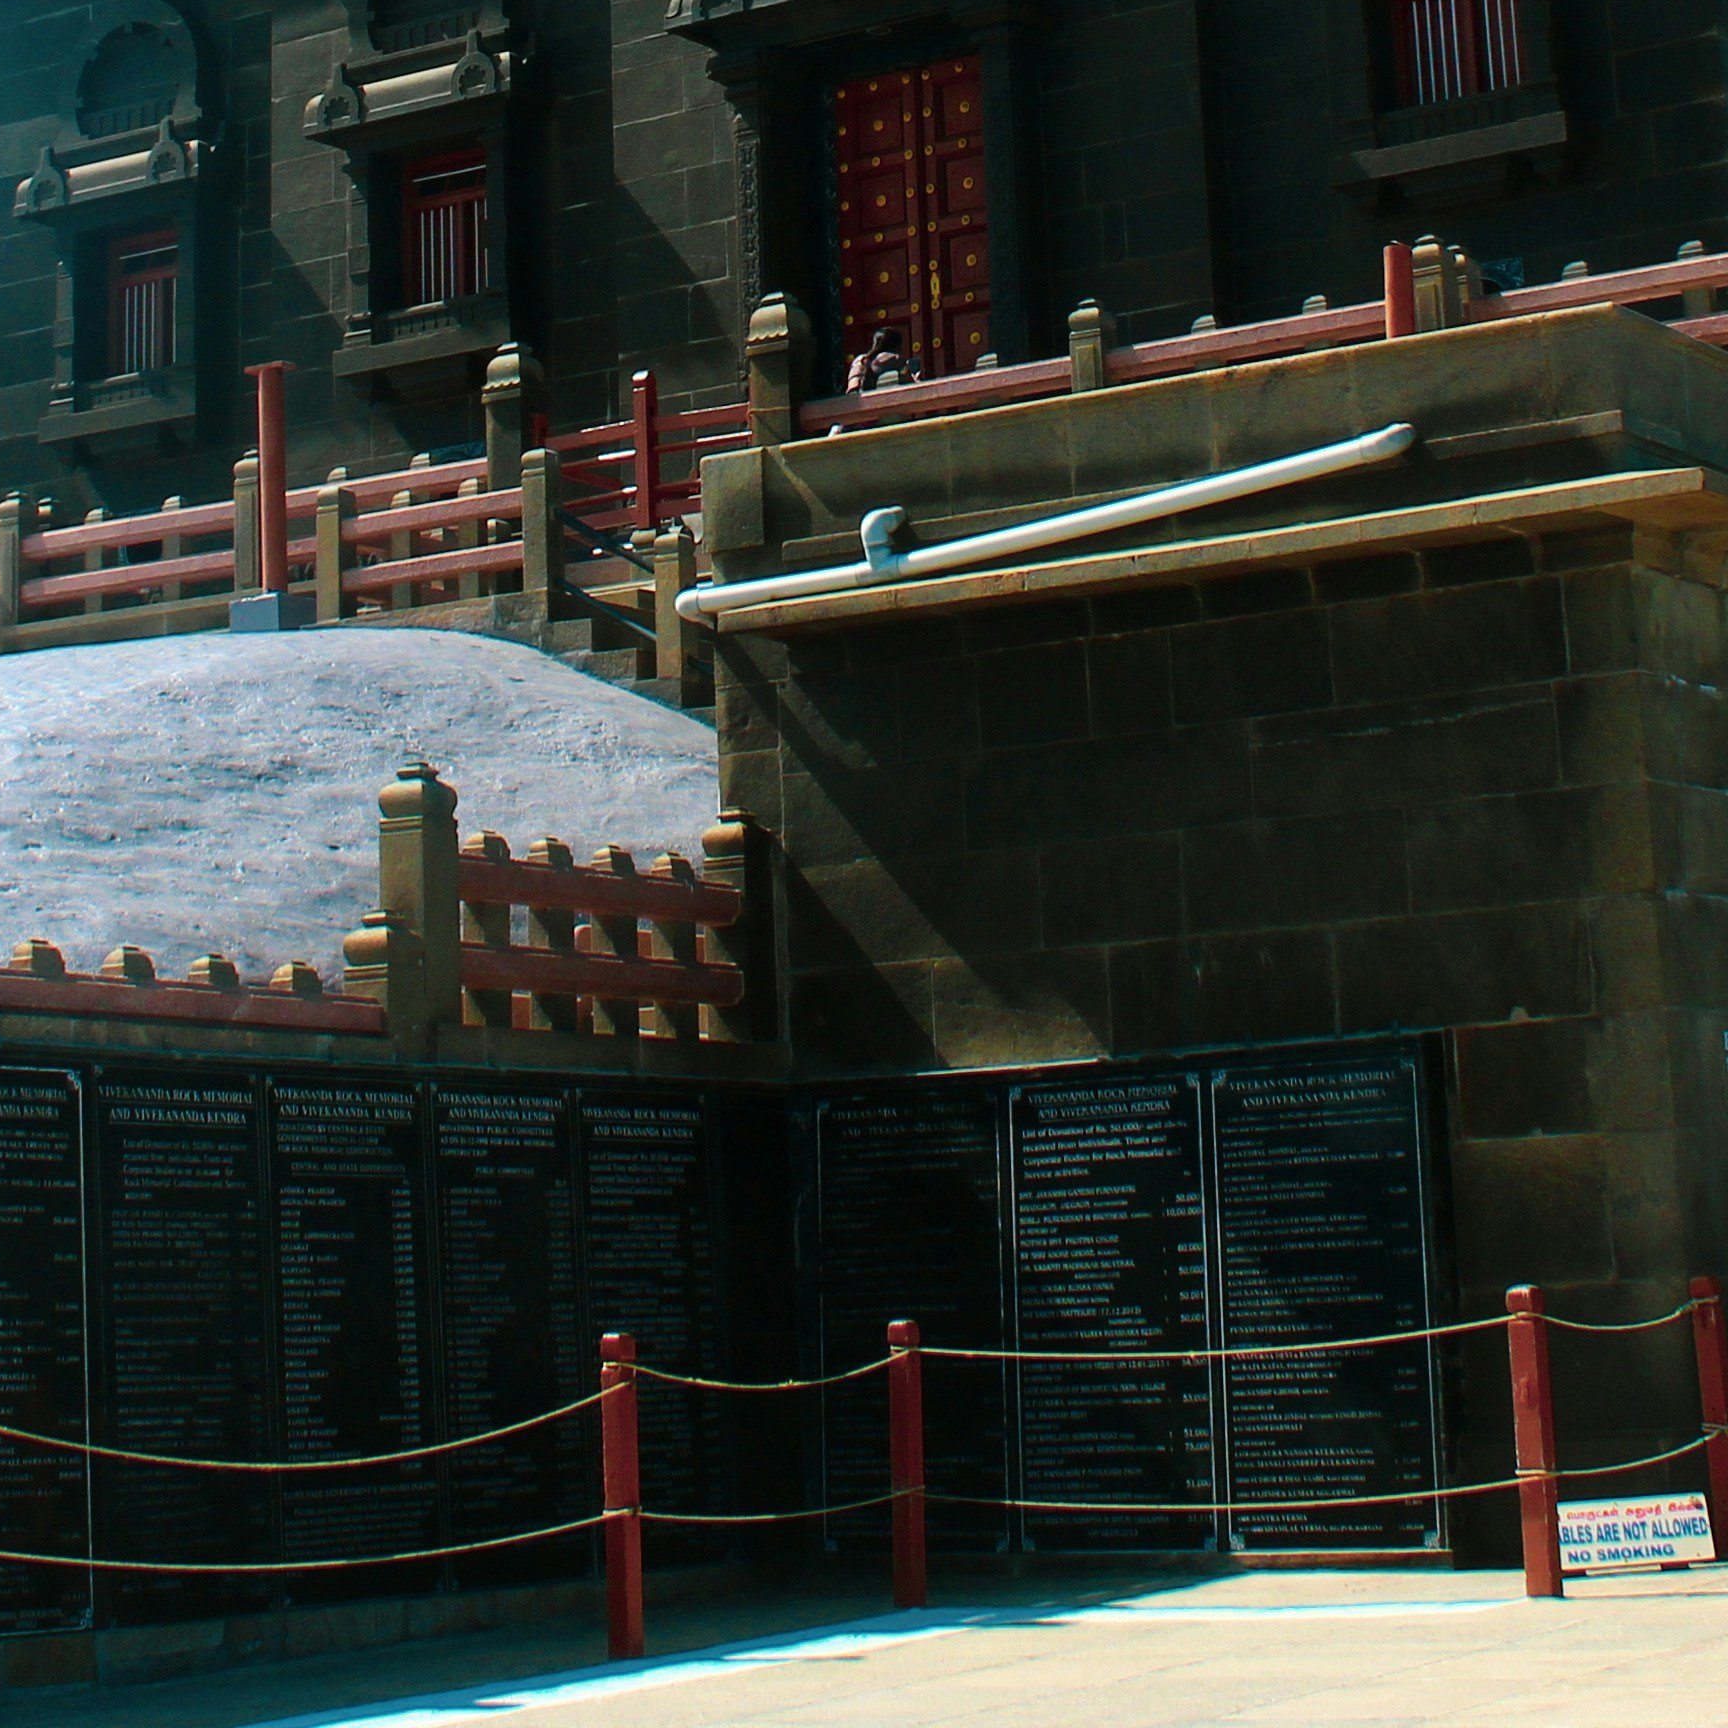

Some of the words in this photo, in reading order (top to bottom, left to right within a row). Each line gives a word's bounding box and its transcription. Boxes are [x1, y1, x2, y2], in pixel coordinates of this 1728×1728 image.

[1227, 1076, 1305, 1092] VIVEKANANDA
[1306, 1074, 1337, 1087] ROCK
[1339, 1070, 1395, 1085] MEMORIAL
[20, 1087, 68, 1100] MEMORIAL
[98, 1085, 171, 1101] VIVEKANANDA
[173, 1088, 201, 1102] ROCK
[202, 1090, 253, 1104] MEMORIAL
[273, 1087, 333, 1101] VIVEKANANDA
[335, 1090, 362, 1102] ROCK
[364, 1091, 416, 1104] MEMORIAL
[437, 1091, 491, 1105] VIVEKANANDA
[492, 1094, 517, 1107] ROCK
[518, 1096, 563, 1109] MEMORIAL
[1028, 1089, 1095, 1105] VIVEKANANDA
[1098, 1087, 1126, 1100] ROCK
[1127, 1084, 1178, 1098] MEMORIAL
[1241, 1096, 1264, 1109] AND
[1265, 1091, 1341, 1106] VIVEKANANDA
[1343, 1088, 1387, 1101] KENDRA
[23, 1105, 60, 1119] KENDRA
[110, 1107, 131, 1119] AND
[134, 1108, 205, 1123] VIVEKANANDA
[207, 1112, 247, 1124] KENDRA
[279, 1104, 299, 1116] AND
[302, 1105, 370, 1118] VIVEKANANDA
[374, 1108, 412, 1120] KENDRA
[448, 1108, 467, 1119] AND
[468, 1108, 520, 1120] VIVEKANANDA
[521, 1110, 555, 1122] KENDRA
[1037, 1107, 1058, 1120] AND
[1060, 1102, 1129, 1117] VIVEKANANDA
[1130, 1099, 1171, 1112] KENDRA
[1596, 1523, 1620, 1542] ARE
[1623, 1521, 1647, 1540] NOT
[1652, 1516, 1708, 1538] ALLOWED
[1567, 1549, 1591, 1563] NO
[1597, 1544, 1674, 1561] SMOKING
